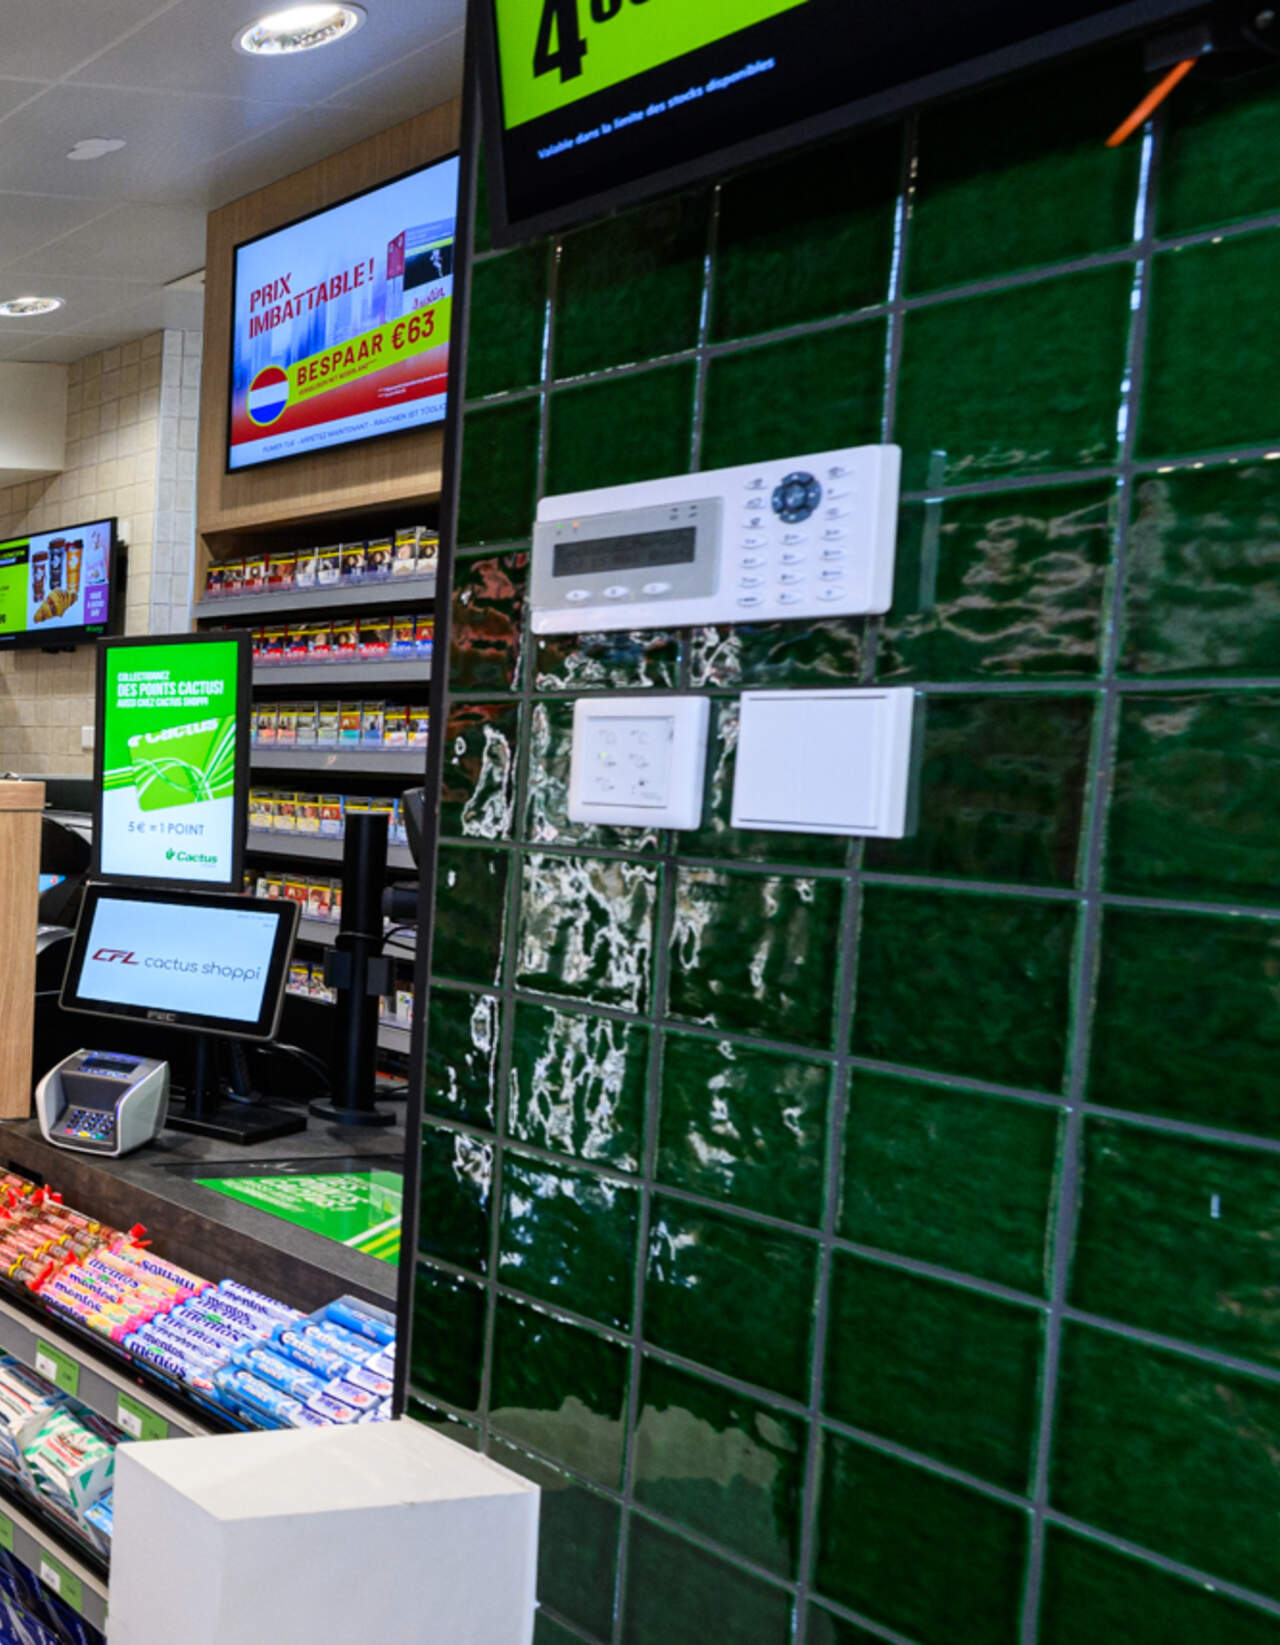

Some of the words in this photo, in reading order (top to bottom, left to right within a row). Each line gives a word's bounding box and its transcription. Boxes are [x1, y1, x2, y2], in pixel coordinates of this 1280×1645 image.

[575, 128, 600, 144] dans
[601, 123, 612, 135] la
[613, 110, 644, 129] limite
[646, 101, 666, 117] des
[667, 86, 704, 108] stocks
[705, 57, 776, 93] disponibles
[250, 272, 292, 313] PRIX
[297, 333, 383, 386] BESPAAR
[391, 309, 435, 350] €63
[117, 683, 137, 696] DES
[139, 681, 177, 696] POINTS
[128, 821, 135, 832] 5
[168, 823, 204, 835] POINT
[176, 851, 218, 864] Cactus
[92, 948, 139, 966] CFL
[144, 956, 198, 973] cactus
[201, 961, 262, 982] shoppi
